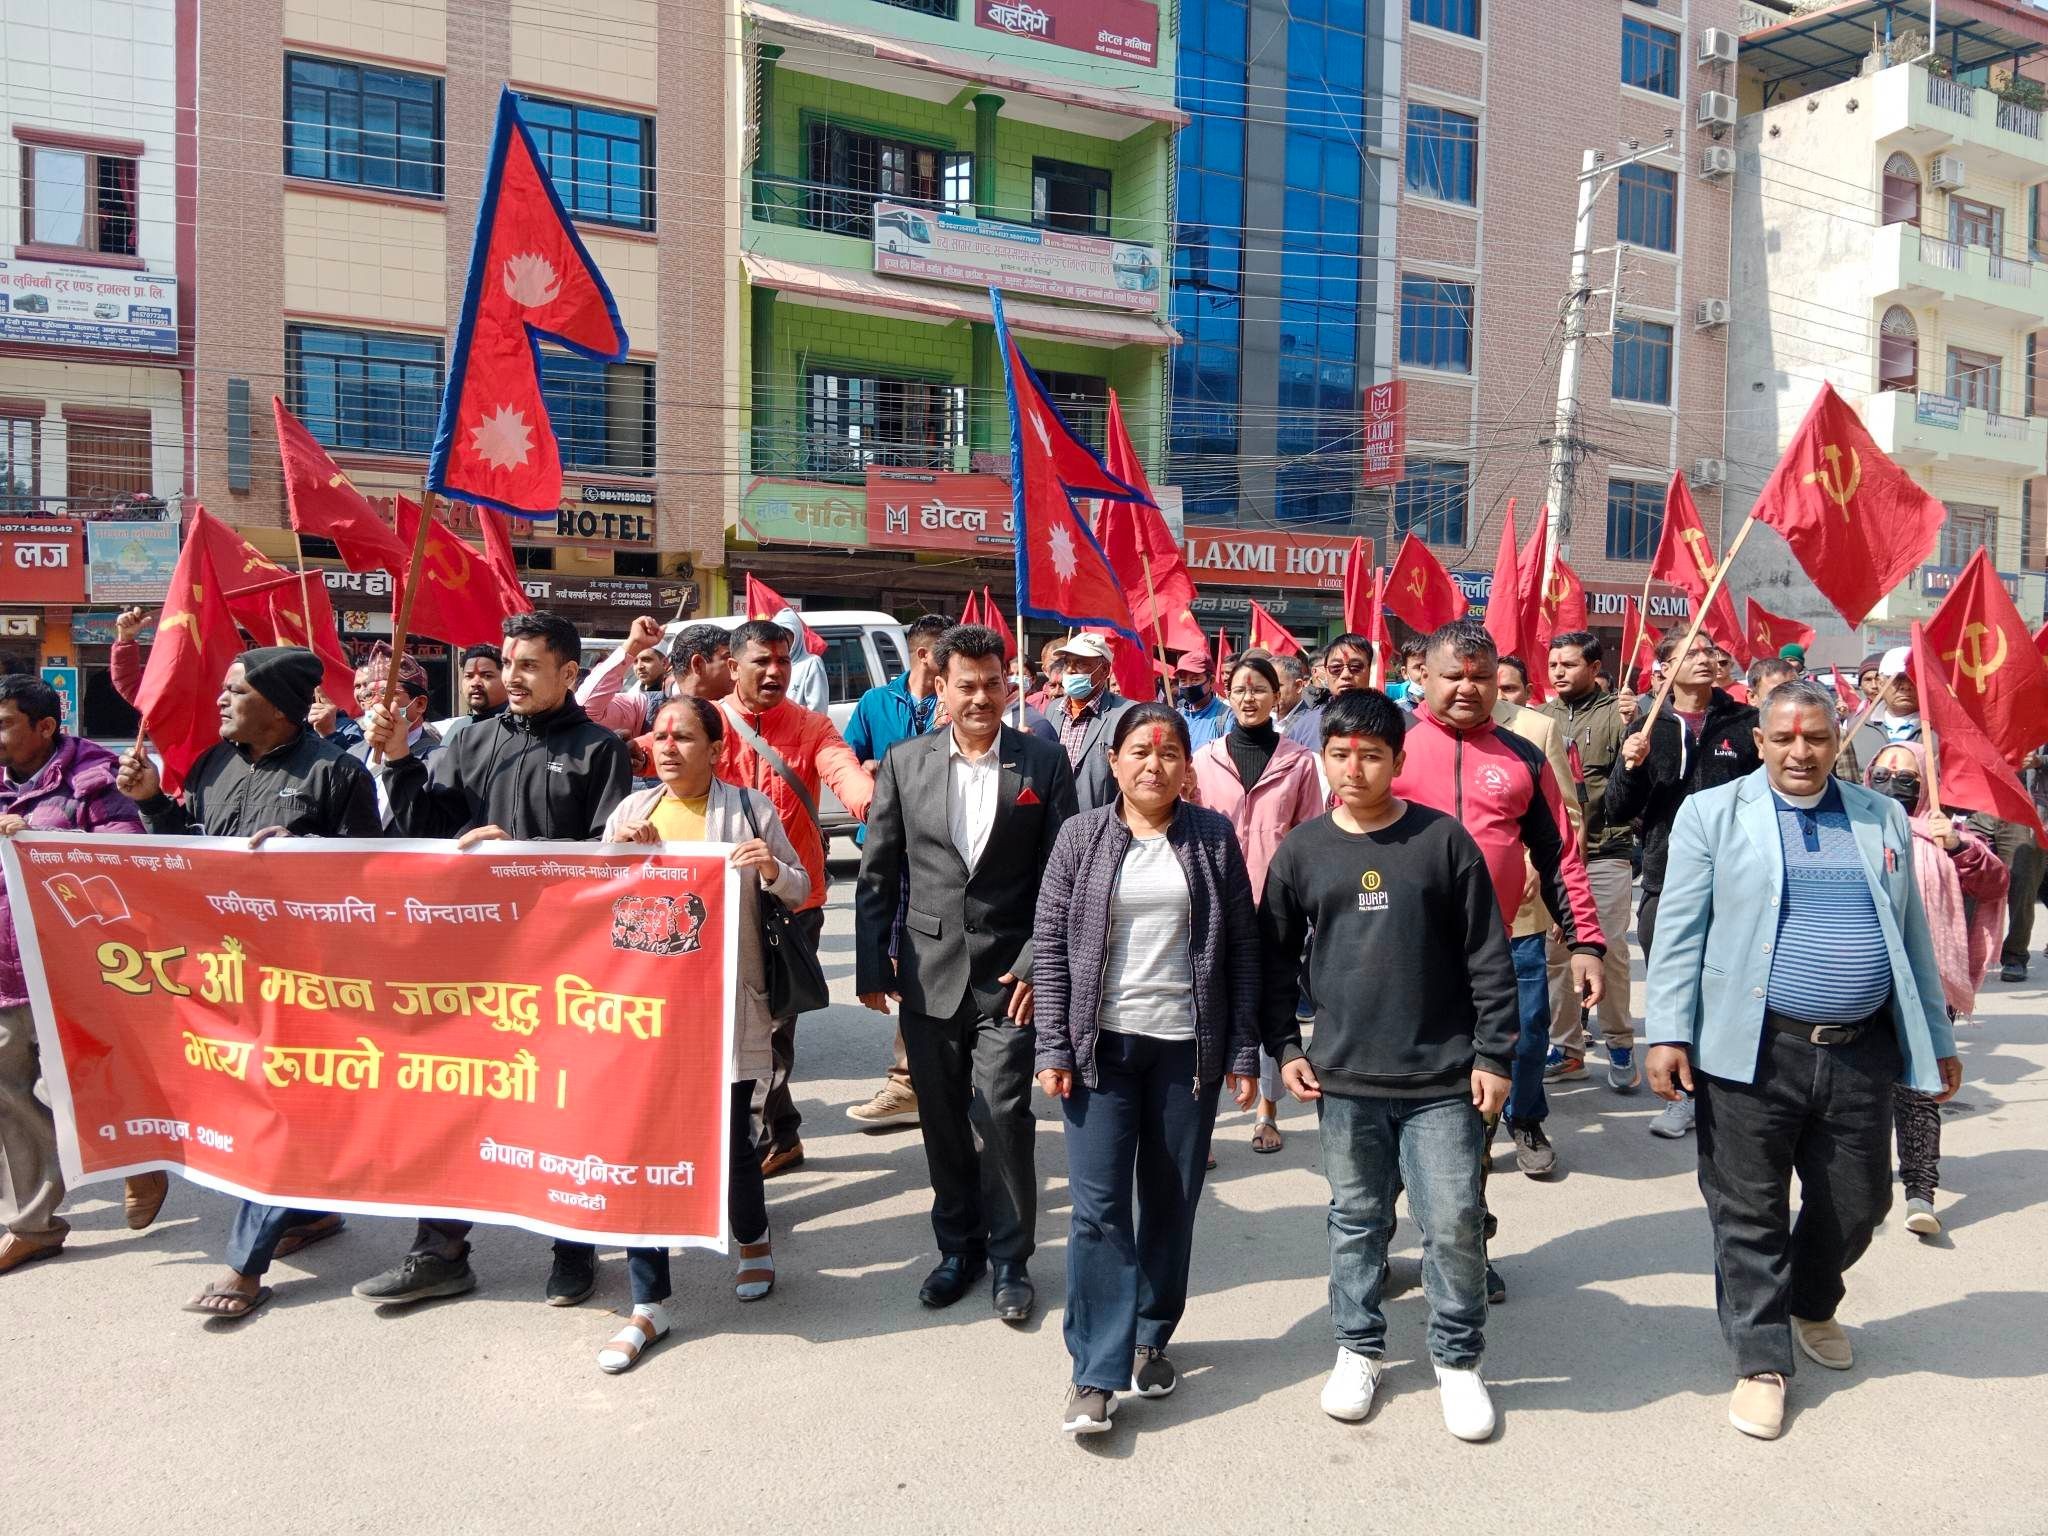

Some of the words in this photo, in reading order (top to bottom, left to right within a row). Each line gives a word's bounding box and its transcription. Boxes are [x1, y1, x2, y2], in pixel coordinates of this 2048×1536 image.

[1098, 30, 1123, 46] होटल
[14, 273, 51, 290] लुम्बिनी
[73, 281, 93, 293] एण्ड
[1367, 421, 1394, 442] LAXMI
[1366, 442, 1387, 457] HOTEL
[556, 509, 650, 541] HOTEL
[920, 498, 988, 532] होटल
[13, 542, 70, 568] लज
[1186, 539, 1276, 574] LAXMI
[1285, 547, 1352, 577] HOT
[322, 571, 362, 591] गर
[365, 568, 393, 596] हो
[1324, 579, 1343, 589] LODGE
[1190, 597, 1219, 611] टल
[67, 849, 93, 864] श्रमिक
[95, 853, 121, 866] जनता
[131, 855, 162, 872] एकजुट
[642, 864, 688, 881] जिन्दावाद
[206, 891, 278, 922] एकीकृत
[283, 896, 376, 923] जनक्रान्ति
[405, 897, 501, 924] जिन्दावाद
[96, 941, 191, 996] २८
[258, 966, 376, 1012] महान
[385, 982, 542, 1036] जनयुद्ध
[555, 973, 666, 1040] दिवस
[182, 1031, 254, 1081] भव्य
[262, 1037, 384, 1091] रूपले
[99, 1124, 117, 1141] १
[480, 1136, 535, 1169] नेपाल
[539, 1151, 640, 1185] कम्युनिस्ट
[645, 1161, 696, 1186] पार्टी
